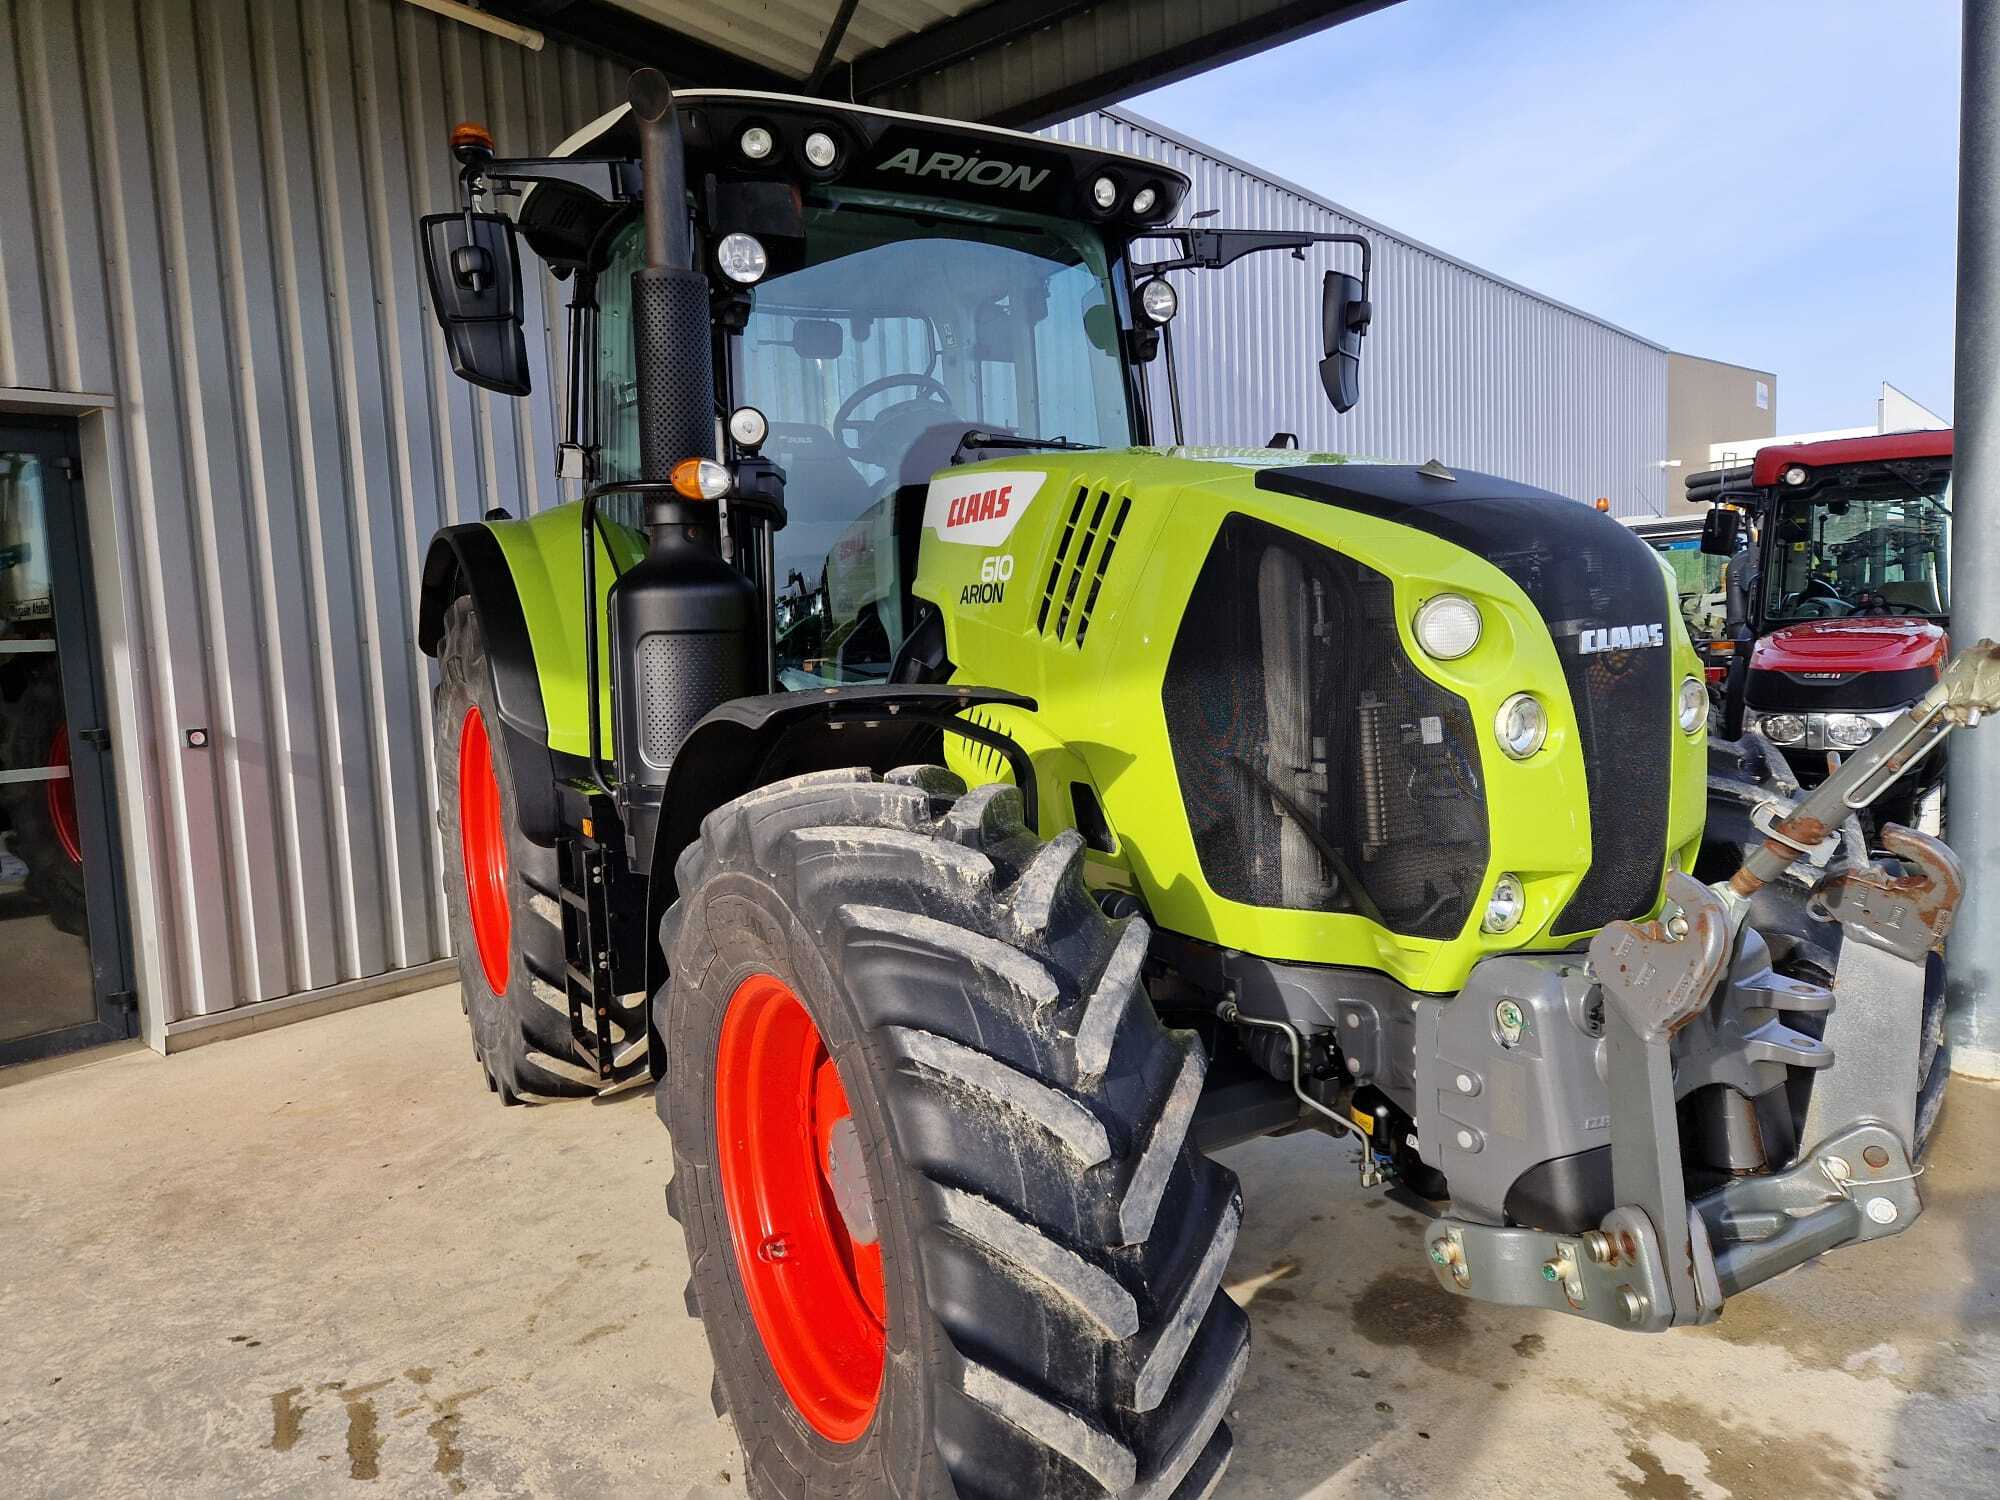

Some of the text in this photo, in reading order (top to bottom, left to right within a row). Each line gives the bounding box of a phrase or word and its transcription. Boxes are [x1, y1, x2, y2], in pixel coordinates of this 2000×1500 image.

[875, 148, 1051, 192] ARION
[946, 485, 1013, 528] CLAAS
[981, 554, 1014, 582] 610
[959, 582, 1004, 604] ARION
[1579, 623, 1664, 655] CLAAS
[1803, 672, 1831, 680] CASE
